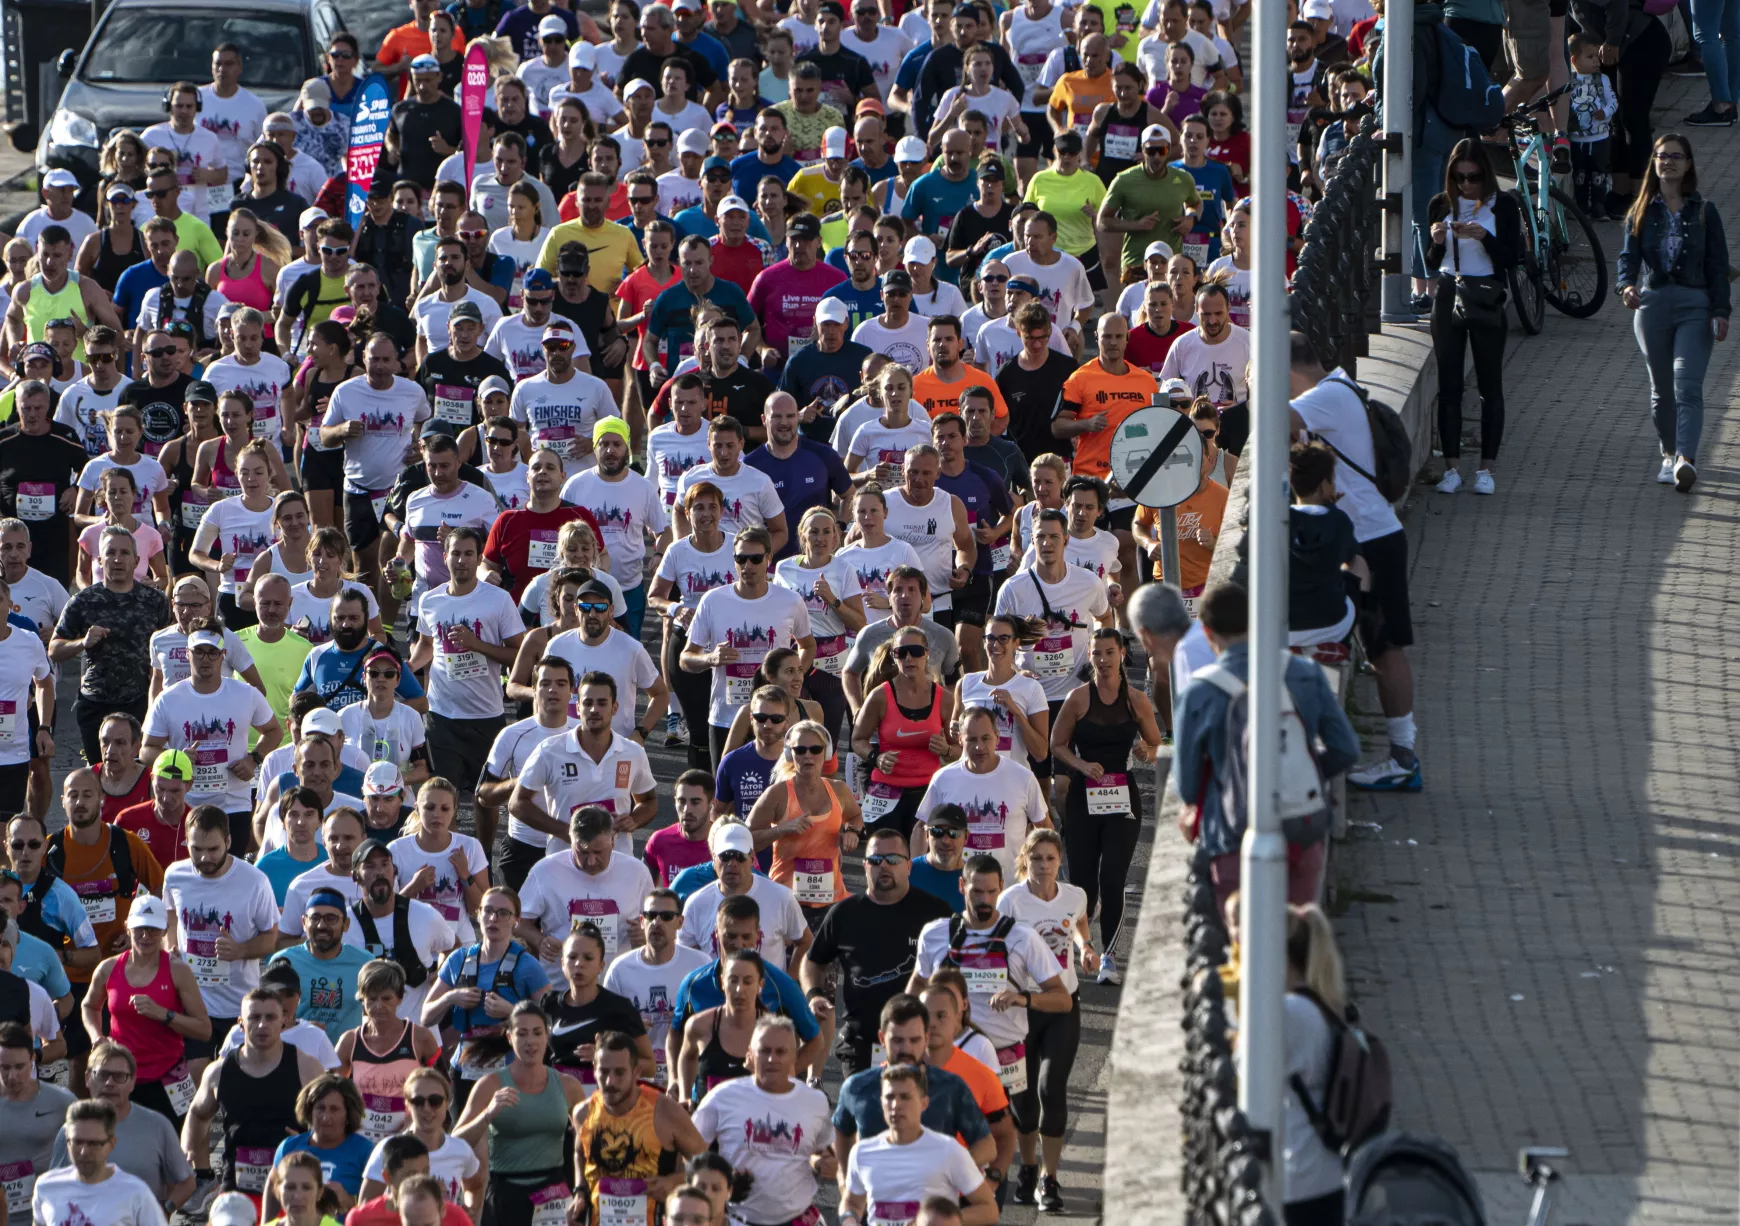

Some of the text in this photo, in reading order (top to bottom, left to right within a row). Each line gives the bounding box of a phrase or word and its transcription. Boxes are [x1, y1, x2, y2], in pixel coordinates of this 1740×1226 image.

[782, 294, 800, 302] Live
[782, 301, 799, 310] Run
[1109, 391, 1145, 402] TIGRA
[442, 400, 464, 408] 10588
[936, 398, 959, 408] TIG
[534, 405, 582, 420] FINISHER
[548, 441, 567, 449] 3630
[28, 497, 43, 505] 305
[456, 653, 474, 662] 3191
[1044, 653, 1064, 661] 3260
[197, 767, 217, 775] 2923
[872, 798, 888, 807] 2152
[197, 958, 217, 967] 2732
[176, 1079, 192, 1092] 207
[369, 1113, 393, 1123] 2042
[608, 1198, 636, 1208] 10607
